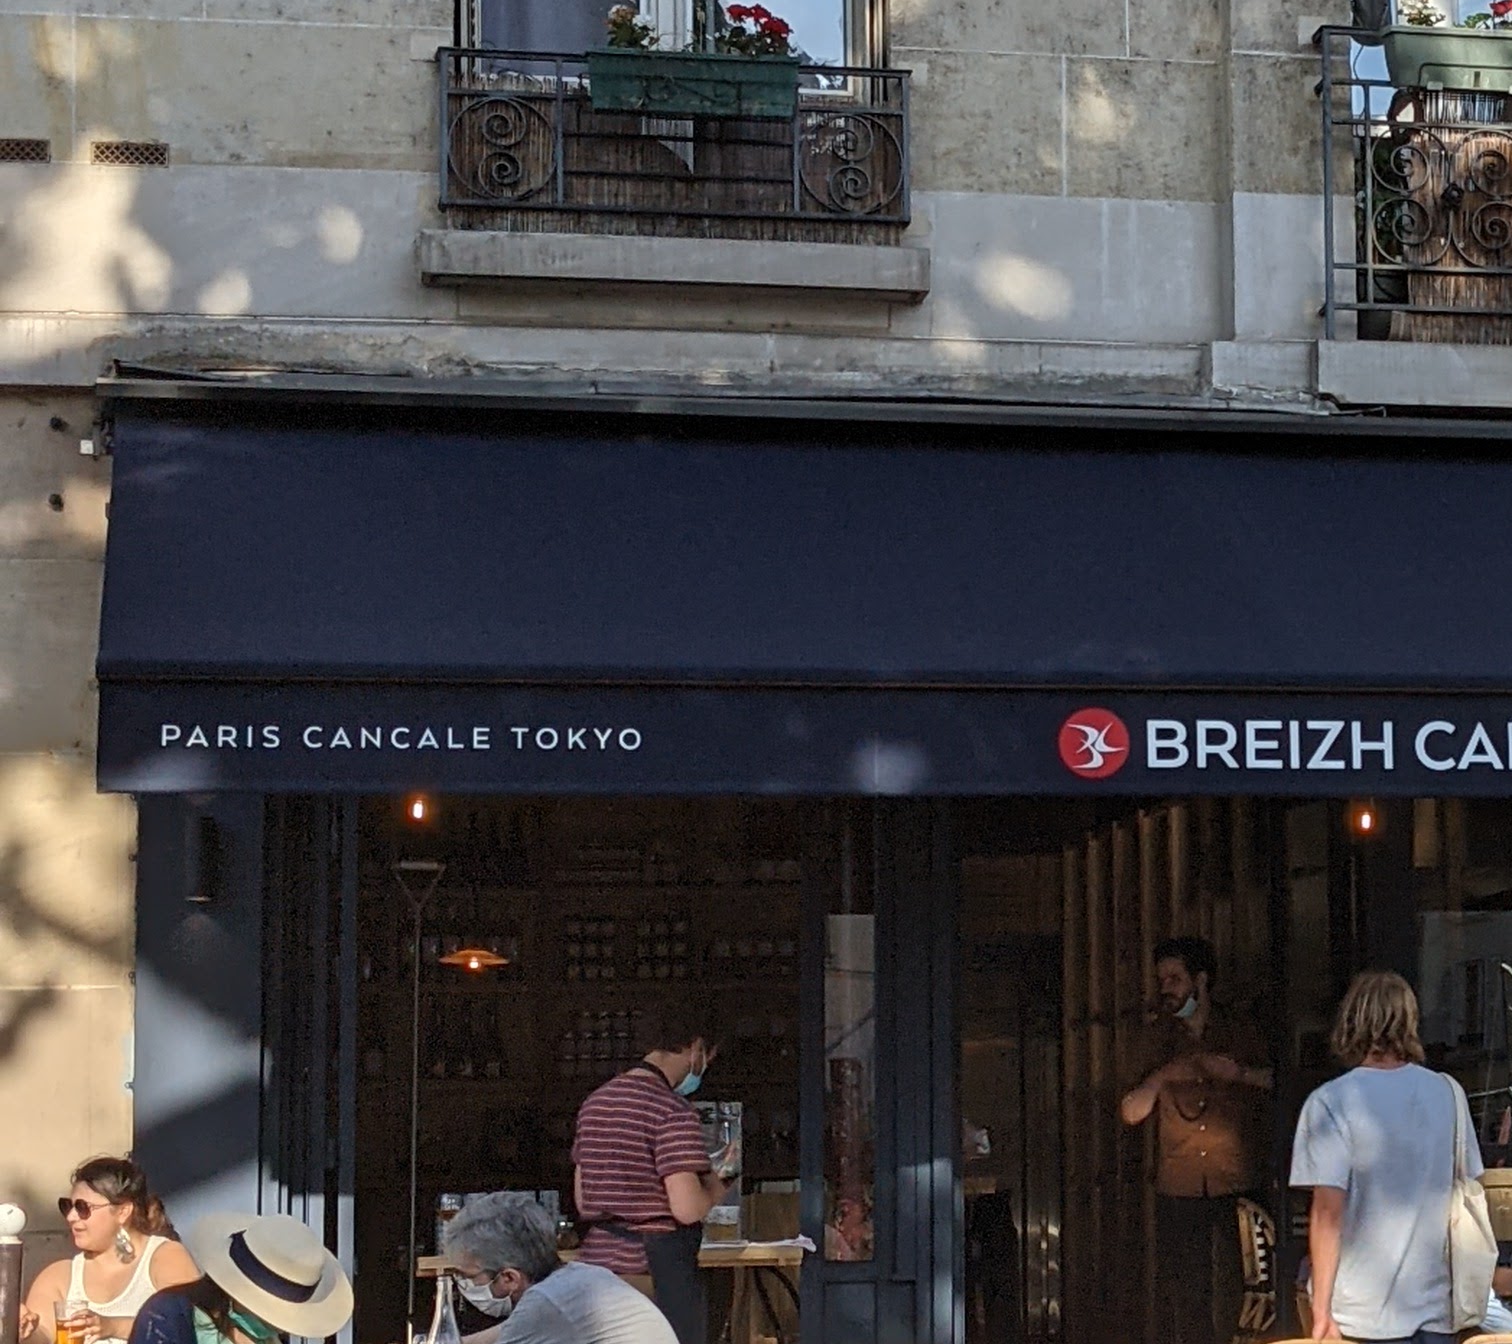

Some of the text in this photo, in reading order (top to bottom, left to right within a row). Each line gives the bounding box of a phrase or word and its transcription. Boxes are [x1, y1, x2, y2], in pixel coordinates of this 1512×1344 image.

[160, 724, 642, 751] PARIS CANCALE TOKYO
[1146, 719, 1394, 770] BREIZH
